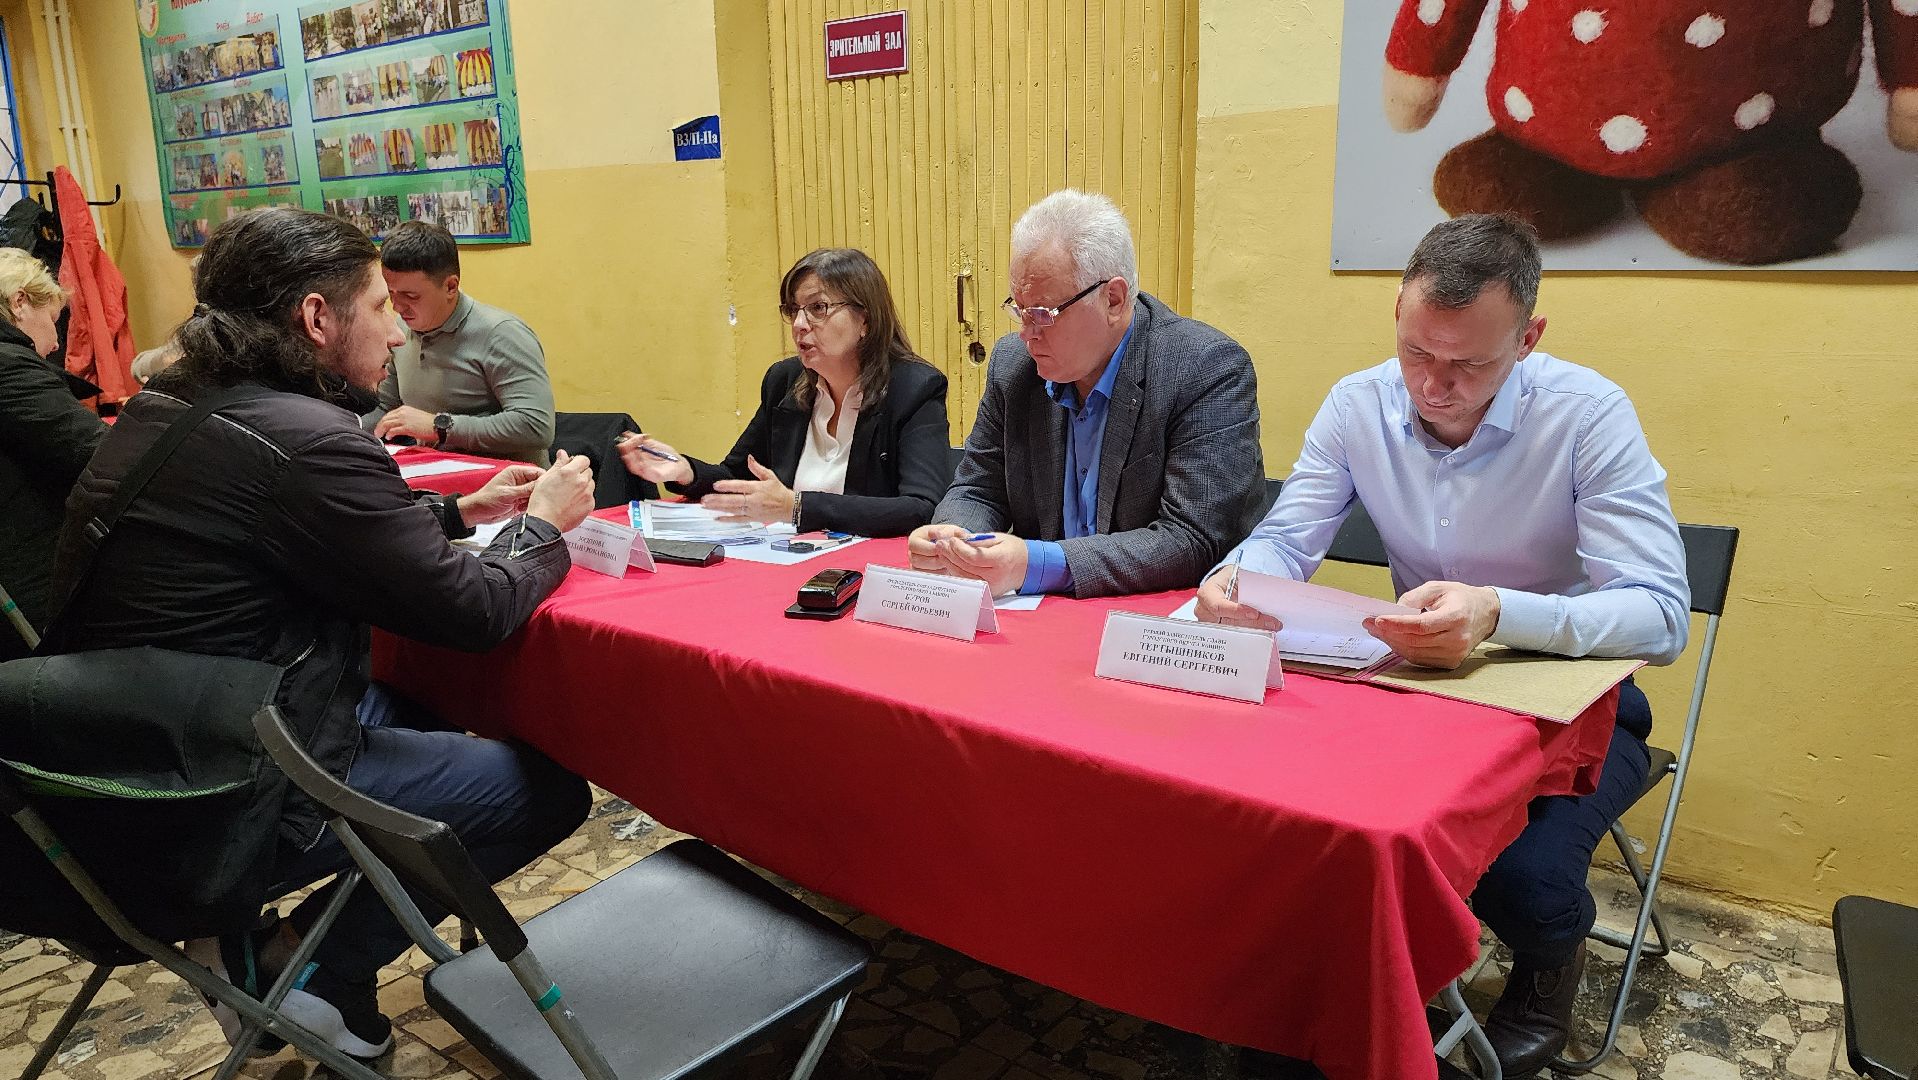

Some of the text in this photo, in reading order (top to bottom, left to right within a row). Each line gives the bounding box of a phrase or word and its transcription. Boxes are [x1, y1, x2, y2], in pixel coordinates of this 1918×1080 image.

[829, 30, 902, 58] ЗРИТЕЛЬНЫЙ ЗАЛ
[881, 599, 951, 619] СЕРГЕЙ ЮРЬЕВИЧ
[1139, 641, 1225, 662] ТЕРТЫШНИКОВ
[1122, 651, 1239, 678] ЕВГЕНИЙ СЕРГЕЕВИЧ
